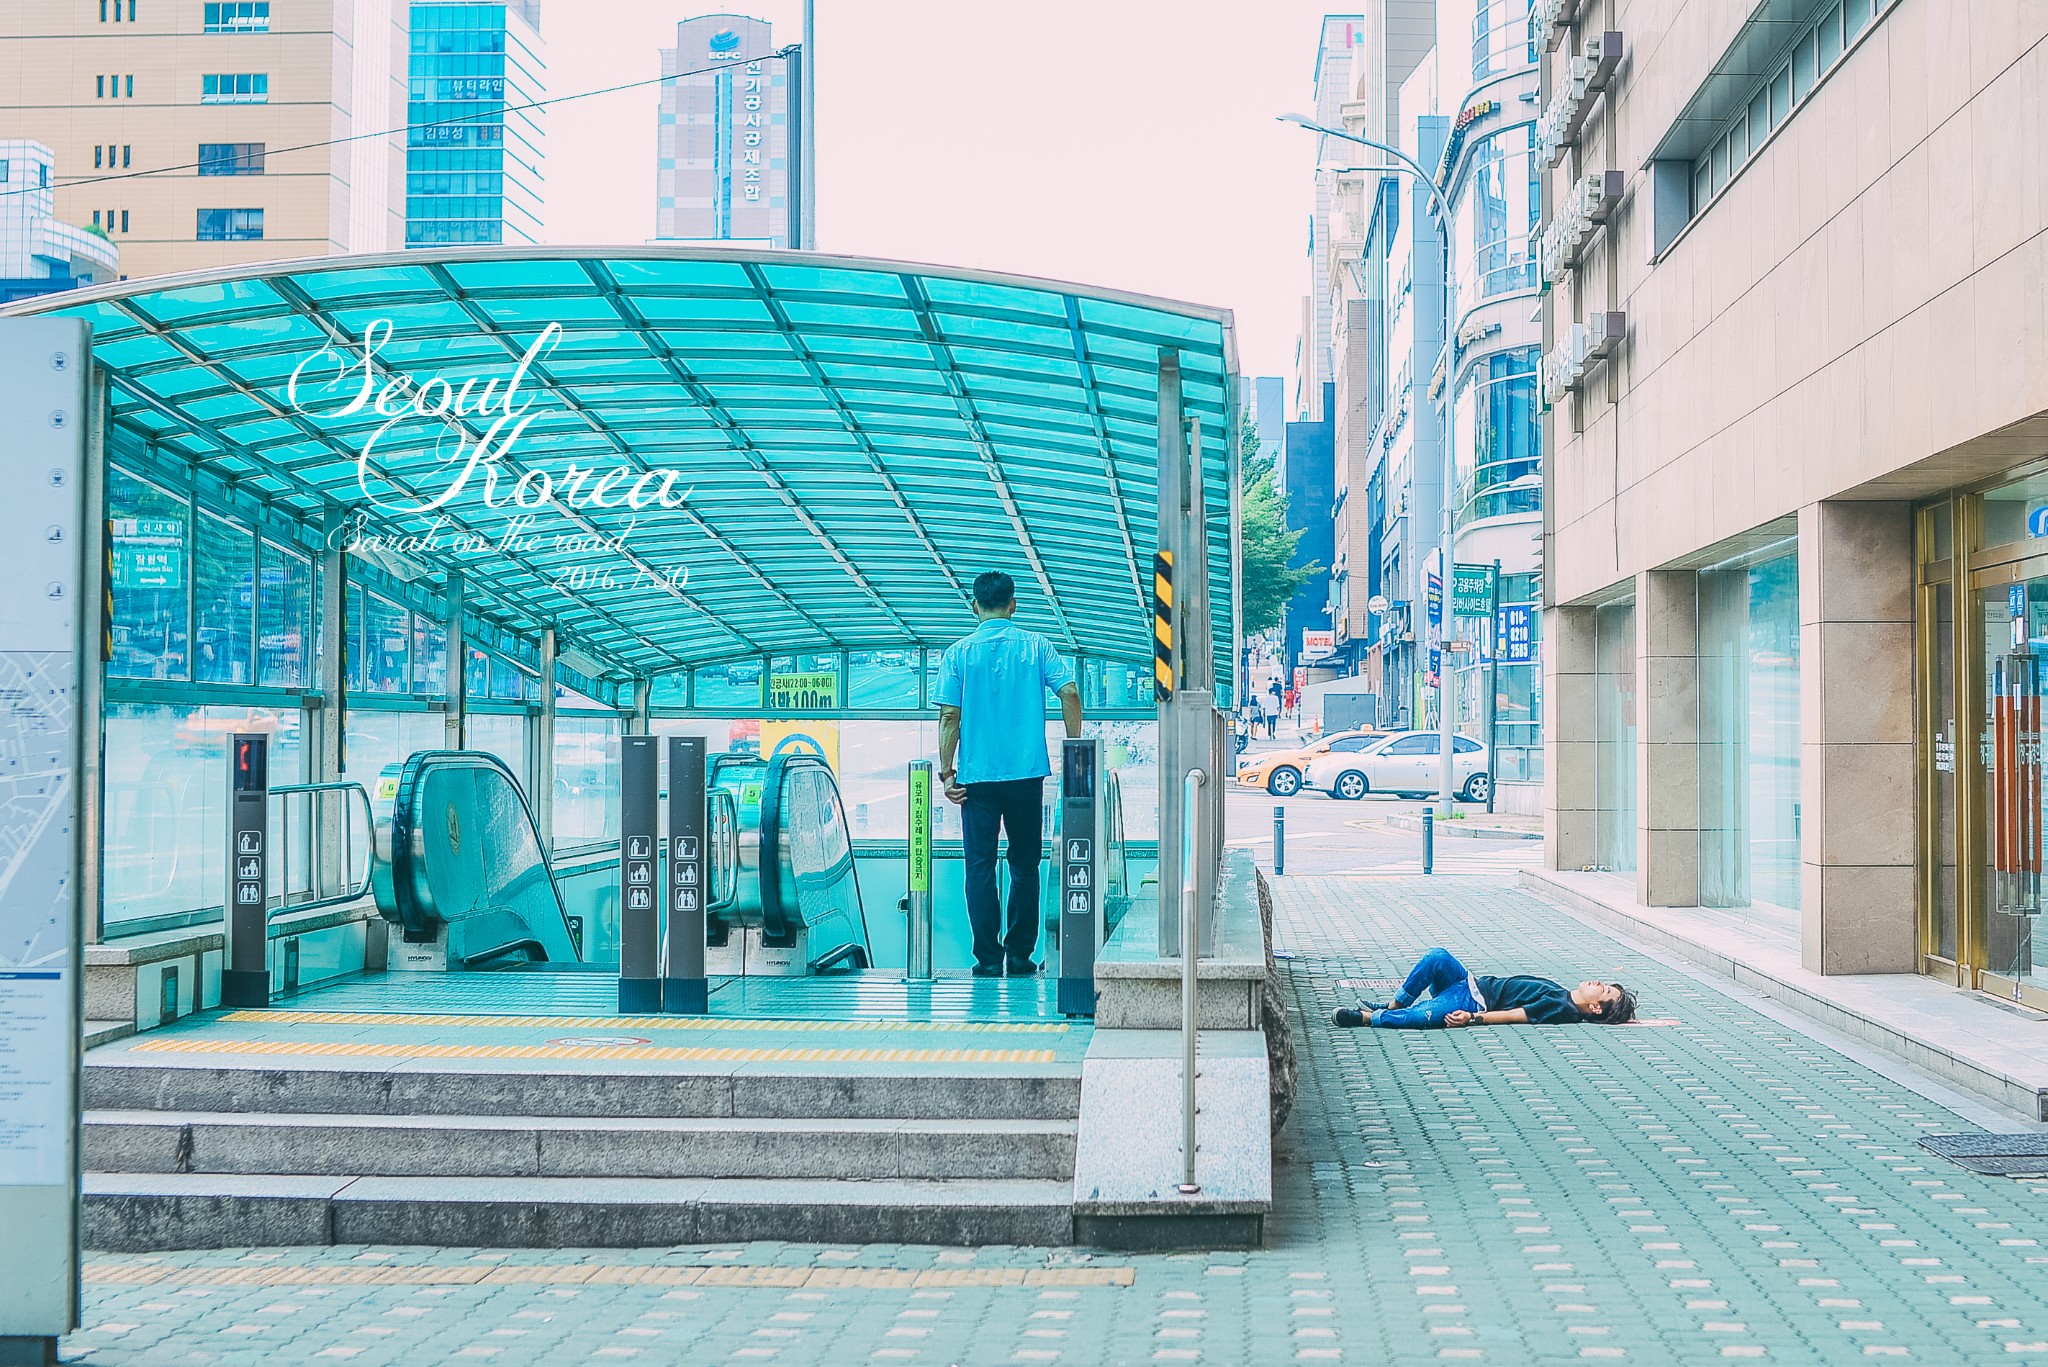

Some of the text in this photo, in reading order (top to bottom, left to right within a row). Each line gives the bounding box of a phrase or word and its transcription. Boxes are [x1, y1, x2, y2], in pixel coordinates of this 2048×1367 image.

[708, 52, 742, 60] ECFC
[426, 127, 464, 140] 김한성
[744, 61, 762, 201] 전기공사공제조합
[1306, 637, 1333, 647] MOTEL
